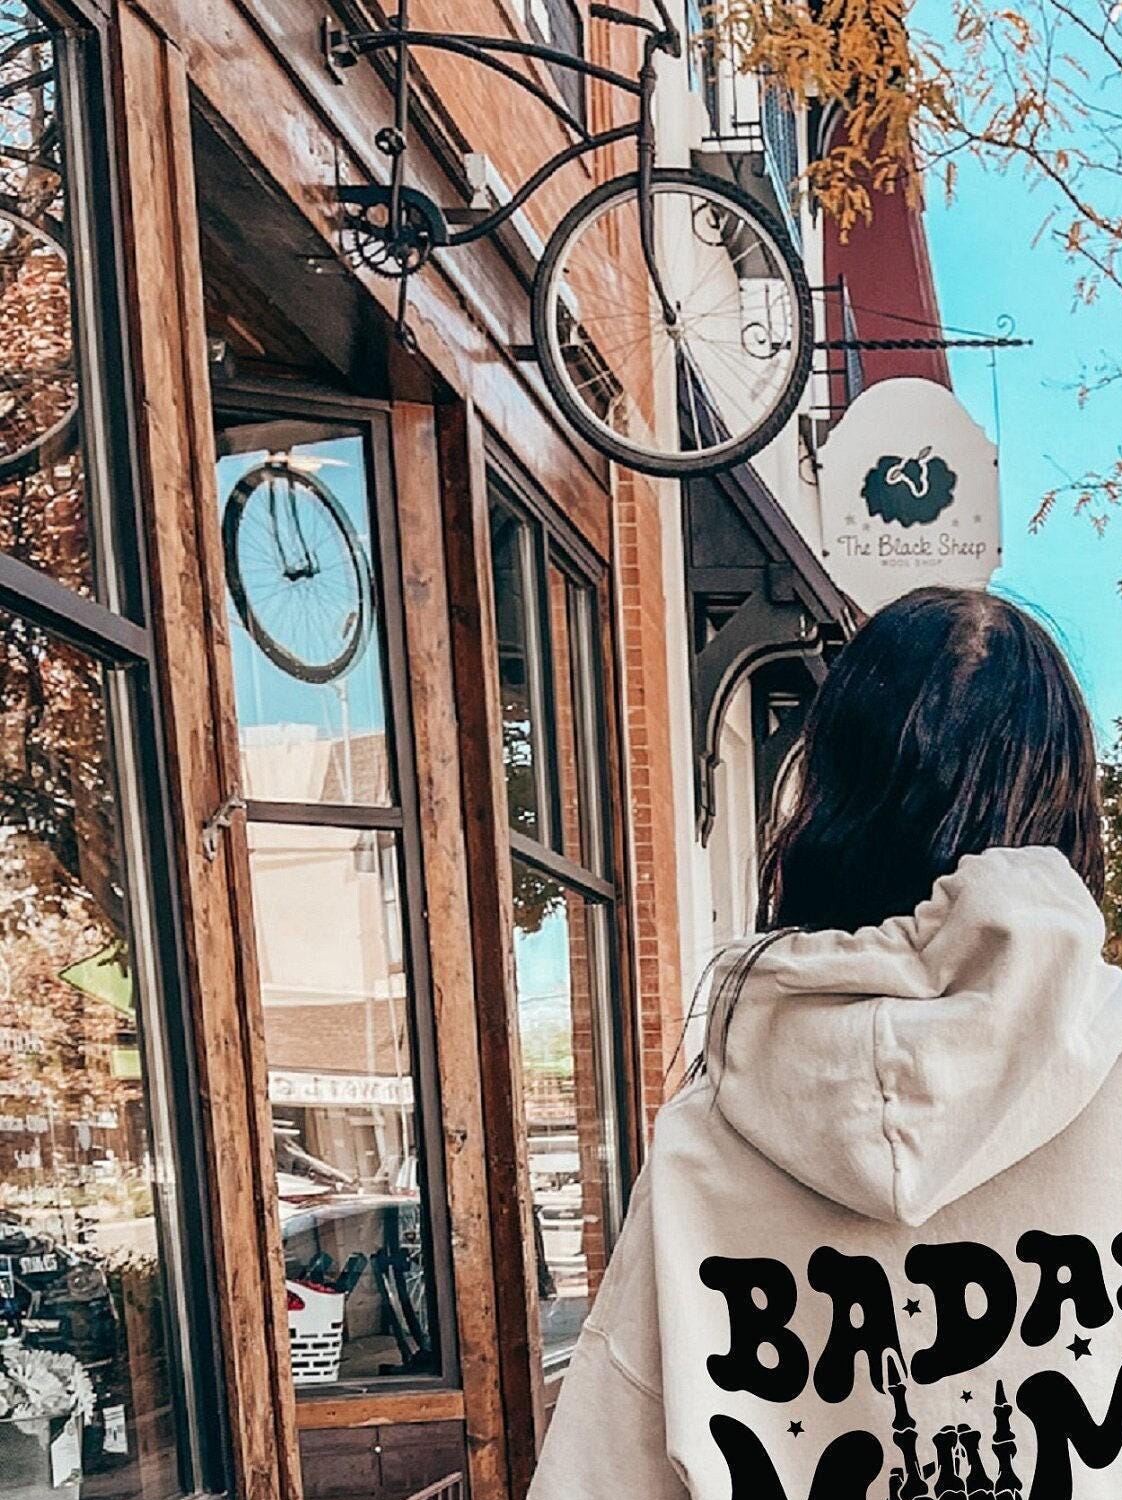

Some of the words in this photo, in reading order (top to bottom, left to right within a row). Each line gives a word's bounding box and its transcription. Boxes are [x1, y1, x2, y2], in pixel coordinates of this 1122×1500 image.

[837, 534, 871, 556] The
[878, 533, 932, 557] Black
[938, 532, 986, 560] Sheep
